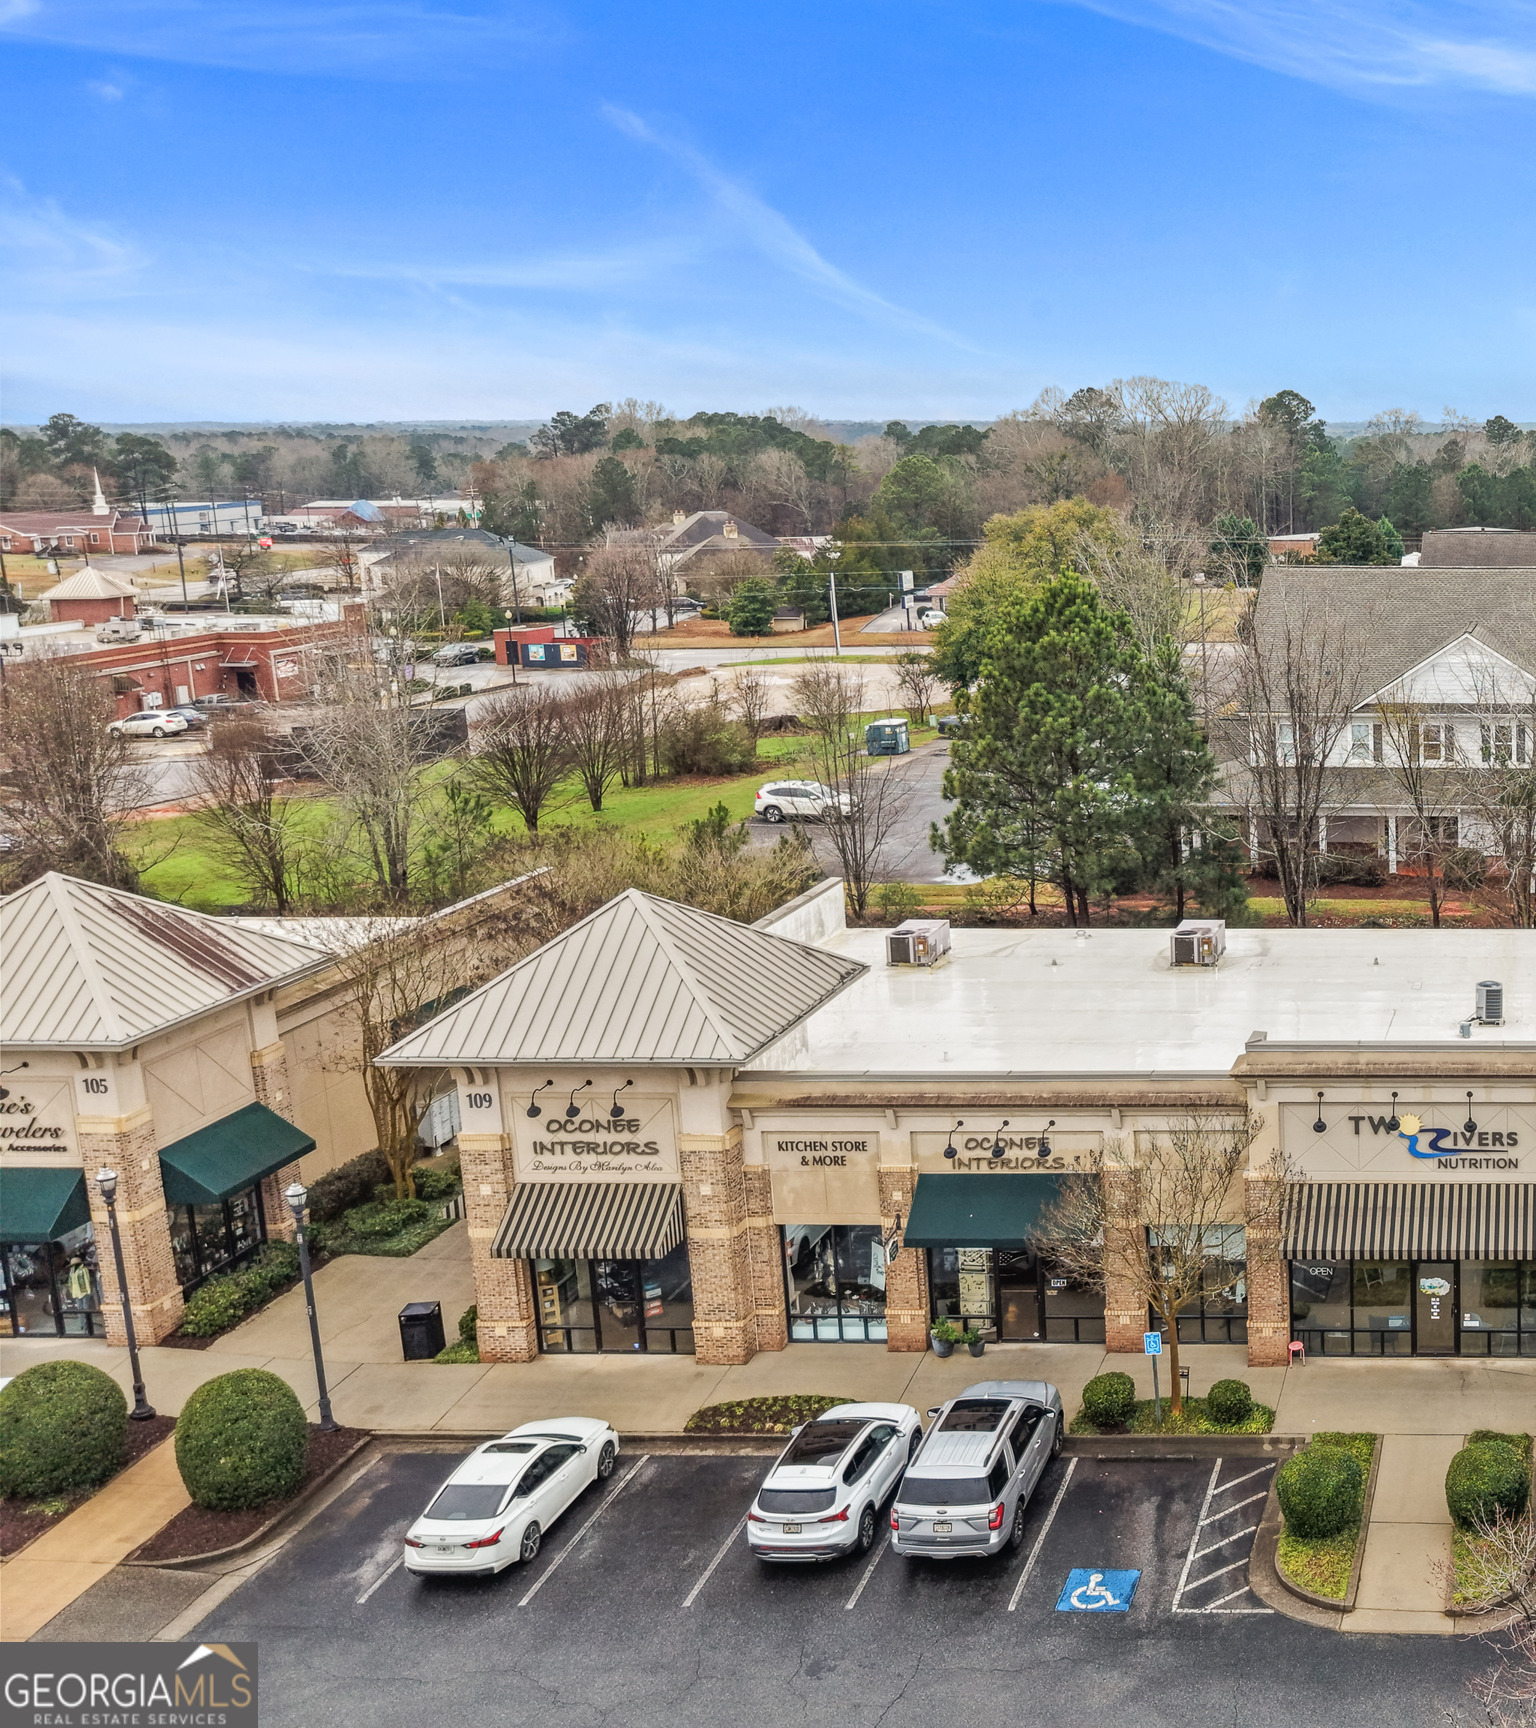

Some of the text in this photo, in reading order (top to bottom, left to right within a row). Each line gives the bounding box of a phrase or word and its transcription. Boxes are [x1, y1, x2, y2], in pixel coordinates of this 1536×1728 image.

[82, 1078, 109, 1094] 105
[466, 1092, 493, 1109] 109
[546, 1119, 641, 1134] OCONEE
[8, 1143, 67, 1152] Accessories
[532, 1140, 660, 1156] INTERIORS
[777, 1140, 868, 1152] KITCHEN STORE
[531, 1160, 567, 1175] Designs
[568, 1160, 588, 1175] By
[589, 1160, 633, 1175] Marilyn
[800, 1155, 847, 1167] & MORE
[951, 1156, 1066, 1171] INTERIORS
[1437, 1157, 1519, 1170] NUTRITION
[1310, 1267, 1334, 1276] OPEN
